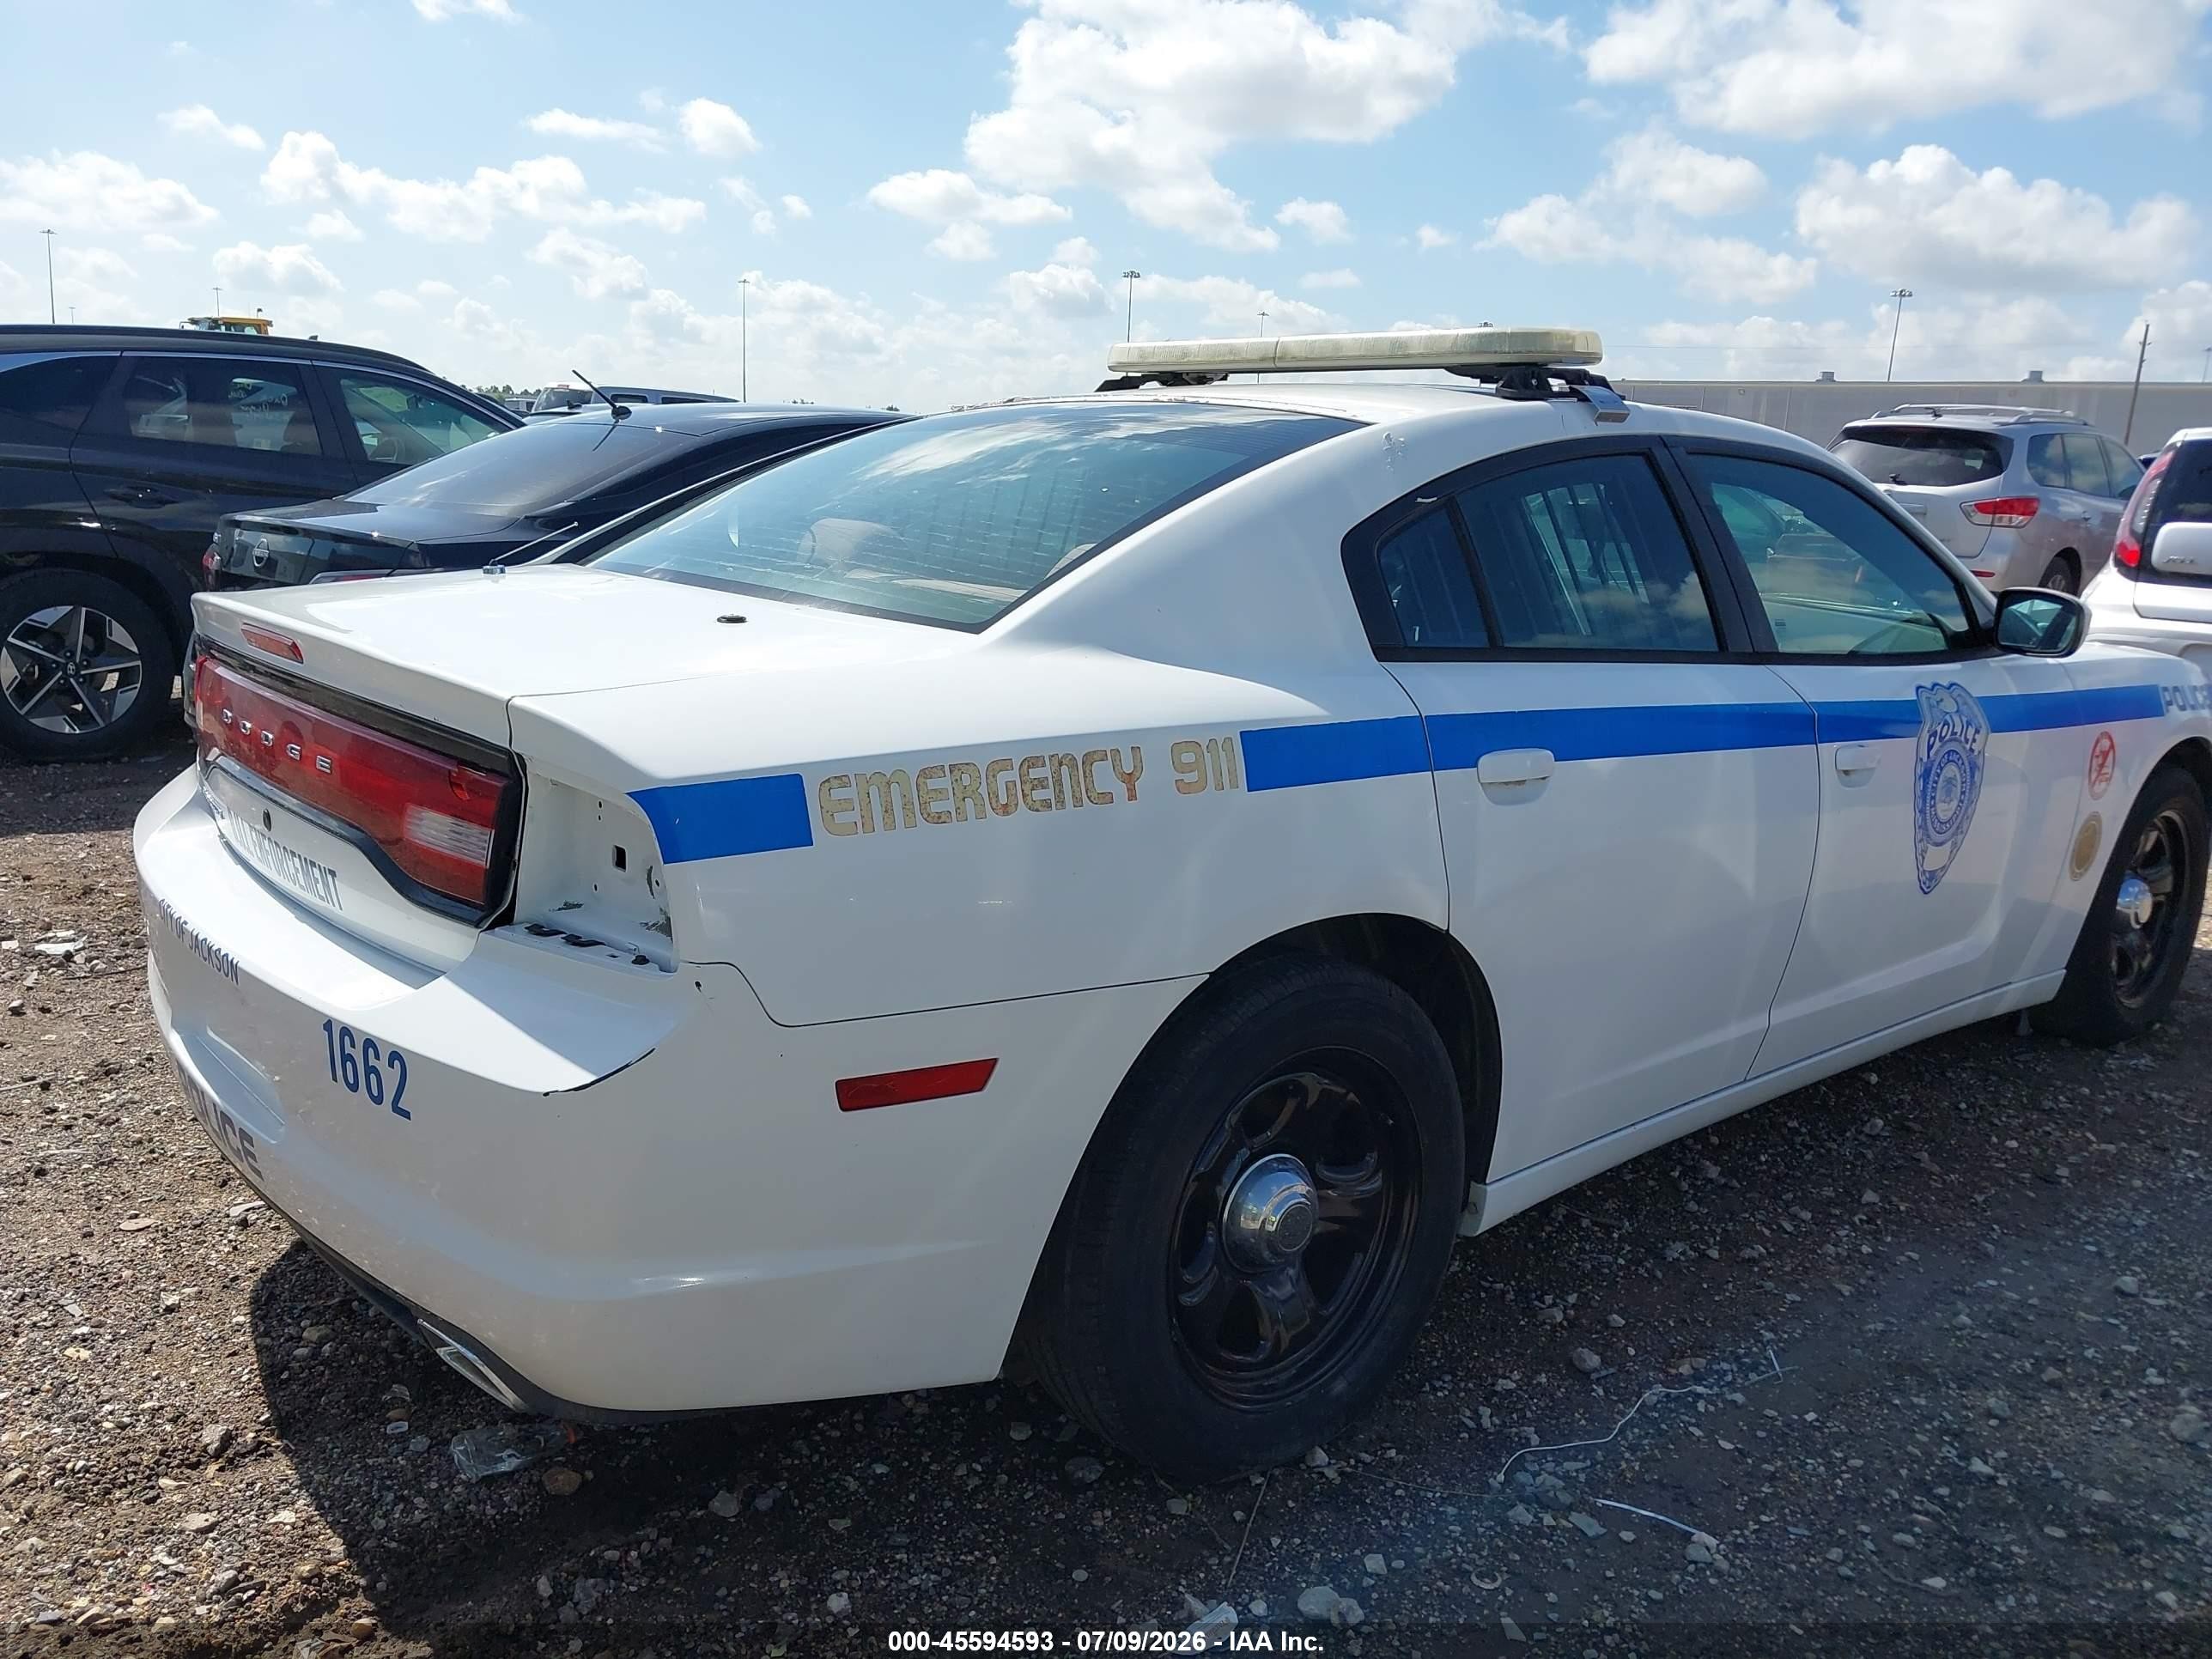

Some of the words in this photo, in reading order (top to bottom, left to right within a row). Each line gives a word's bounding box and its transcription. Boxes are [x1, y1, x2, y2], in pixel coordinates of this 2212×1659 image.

[222, 708, 332, 774] DODGE
[1926, 715, 1982, 759] POLICE
[818, 745, 1144, 836] EMERGENCY
[1170, 736, 1239, 795] 911
[248, 822, 343, 911] ENFORCEMENT
[159, 898, 176, 933] CITY
[175, 915, 189, 943] OF
[189, 927, 240, 986] JACKSON
[322, 1018, 411, 1121] 1662
